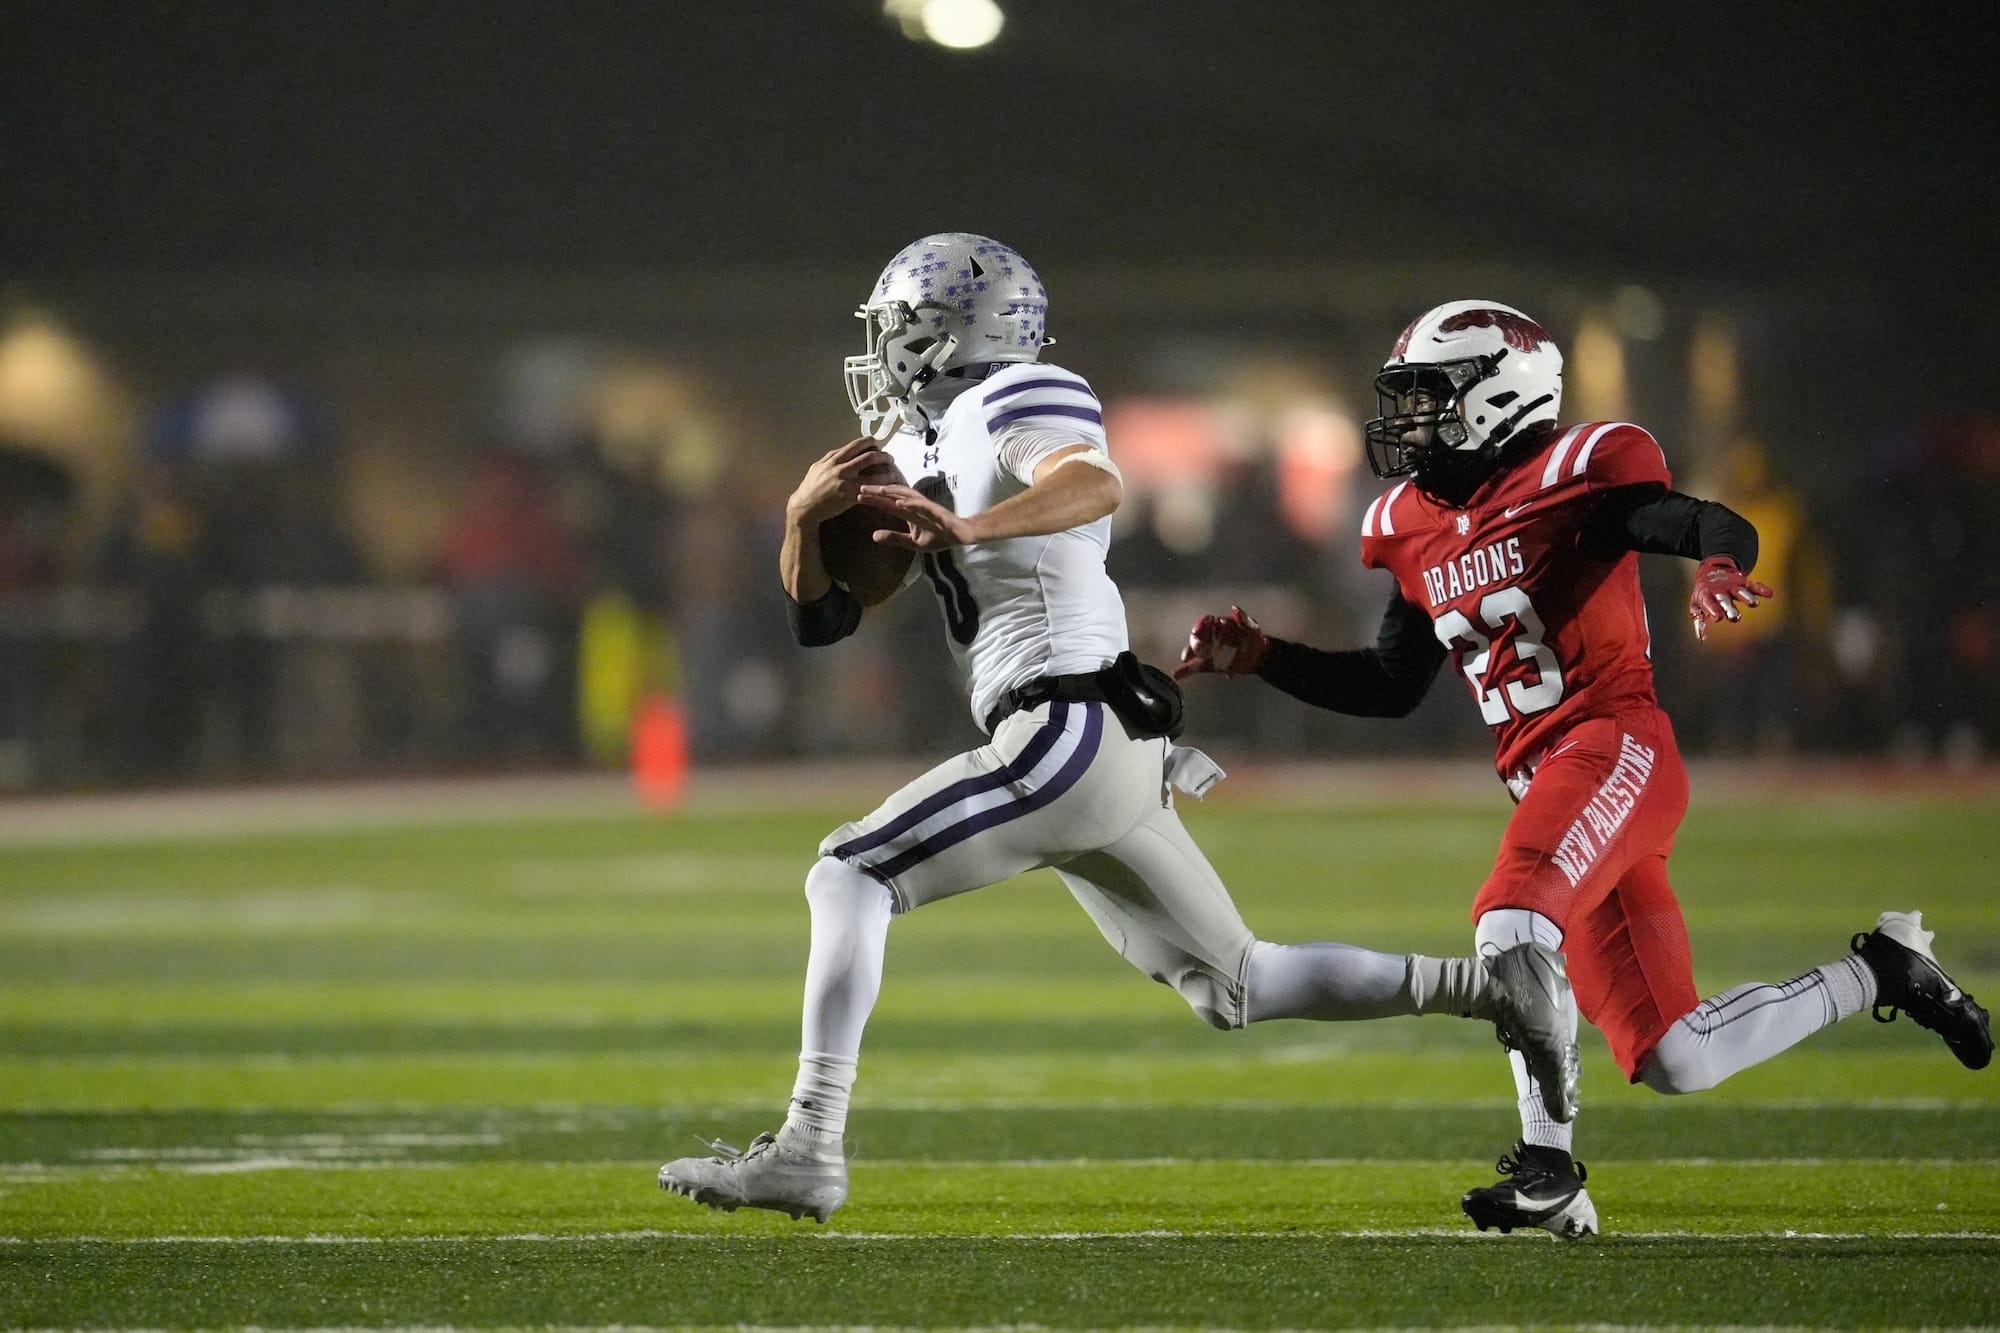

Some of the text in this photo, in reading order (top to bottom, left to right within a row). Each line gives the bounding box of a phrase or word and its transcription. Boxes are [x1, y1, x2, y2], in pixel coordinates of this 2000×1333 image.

[1422, 537, 1525, 607] DRAGONS
[1434, 586, 1564, 726] 23
[1551, 732, 1656, 888] NEW PALESTINE
